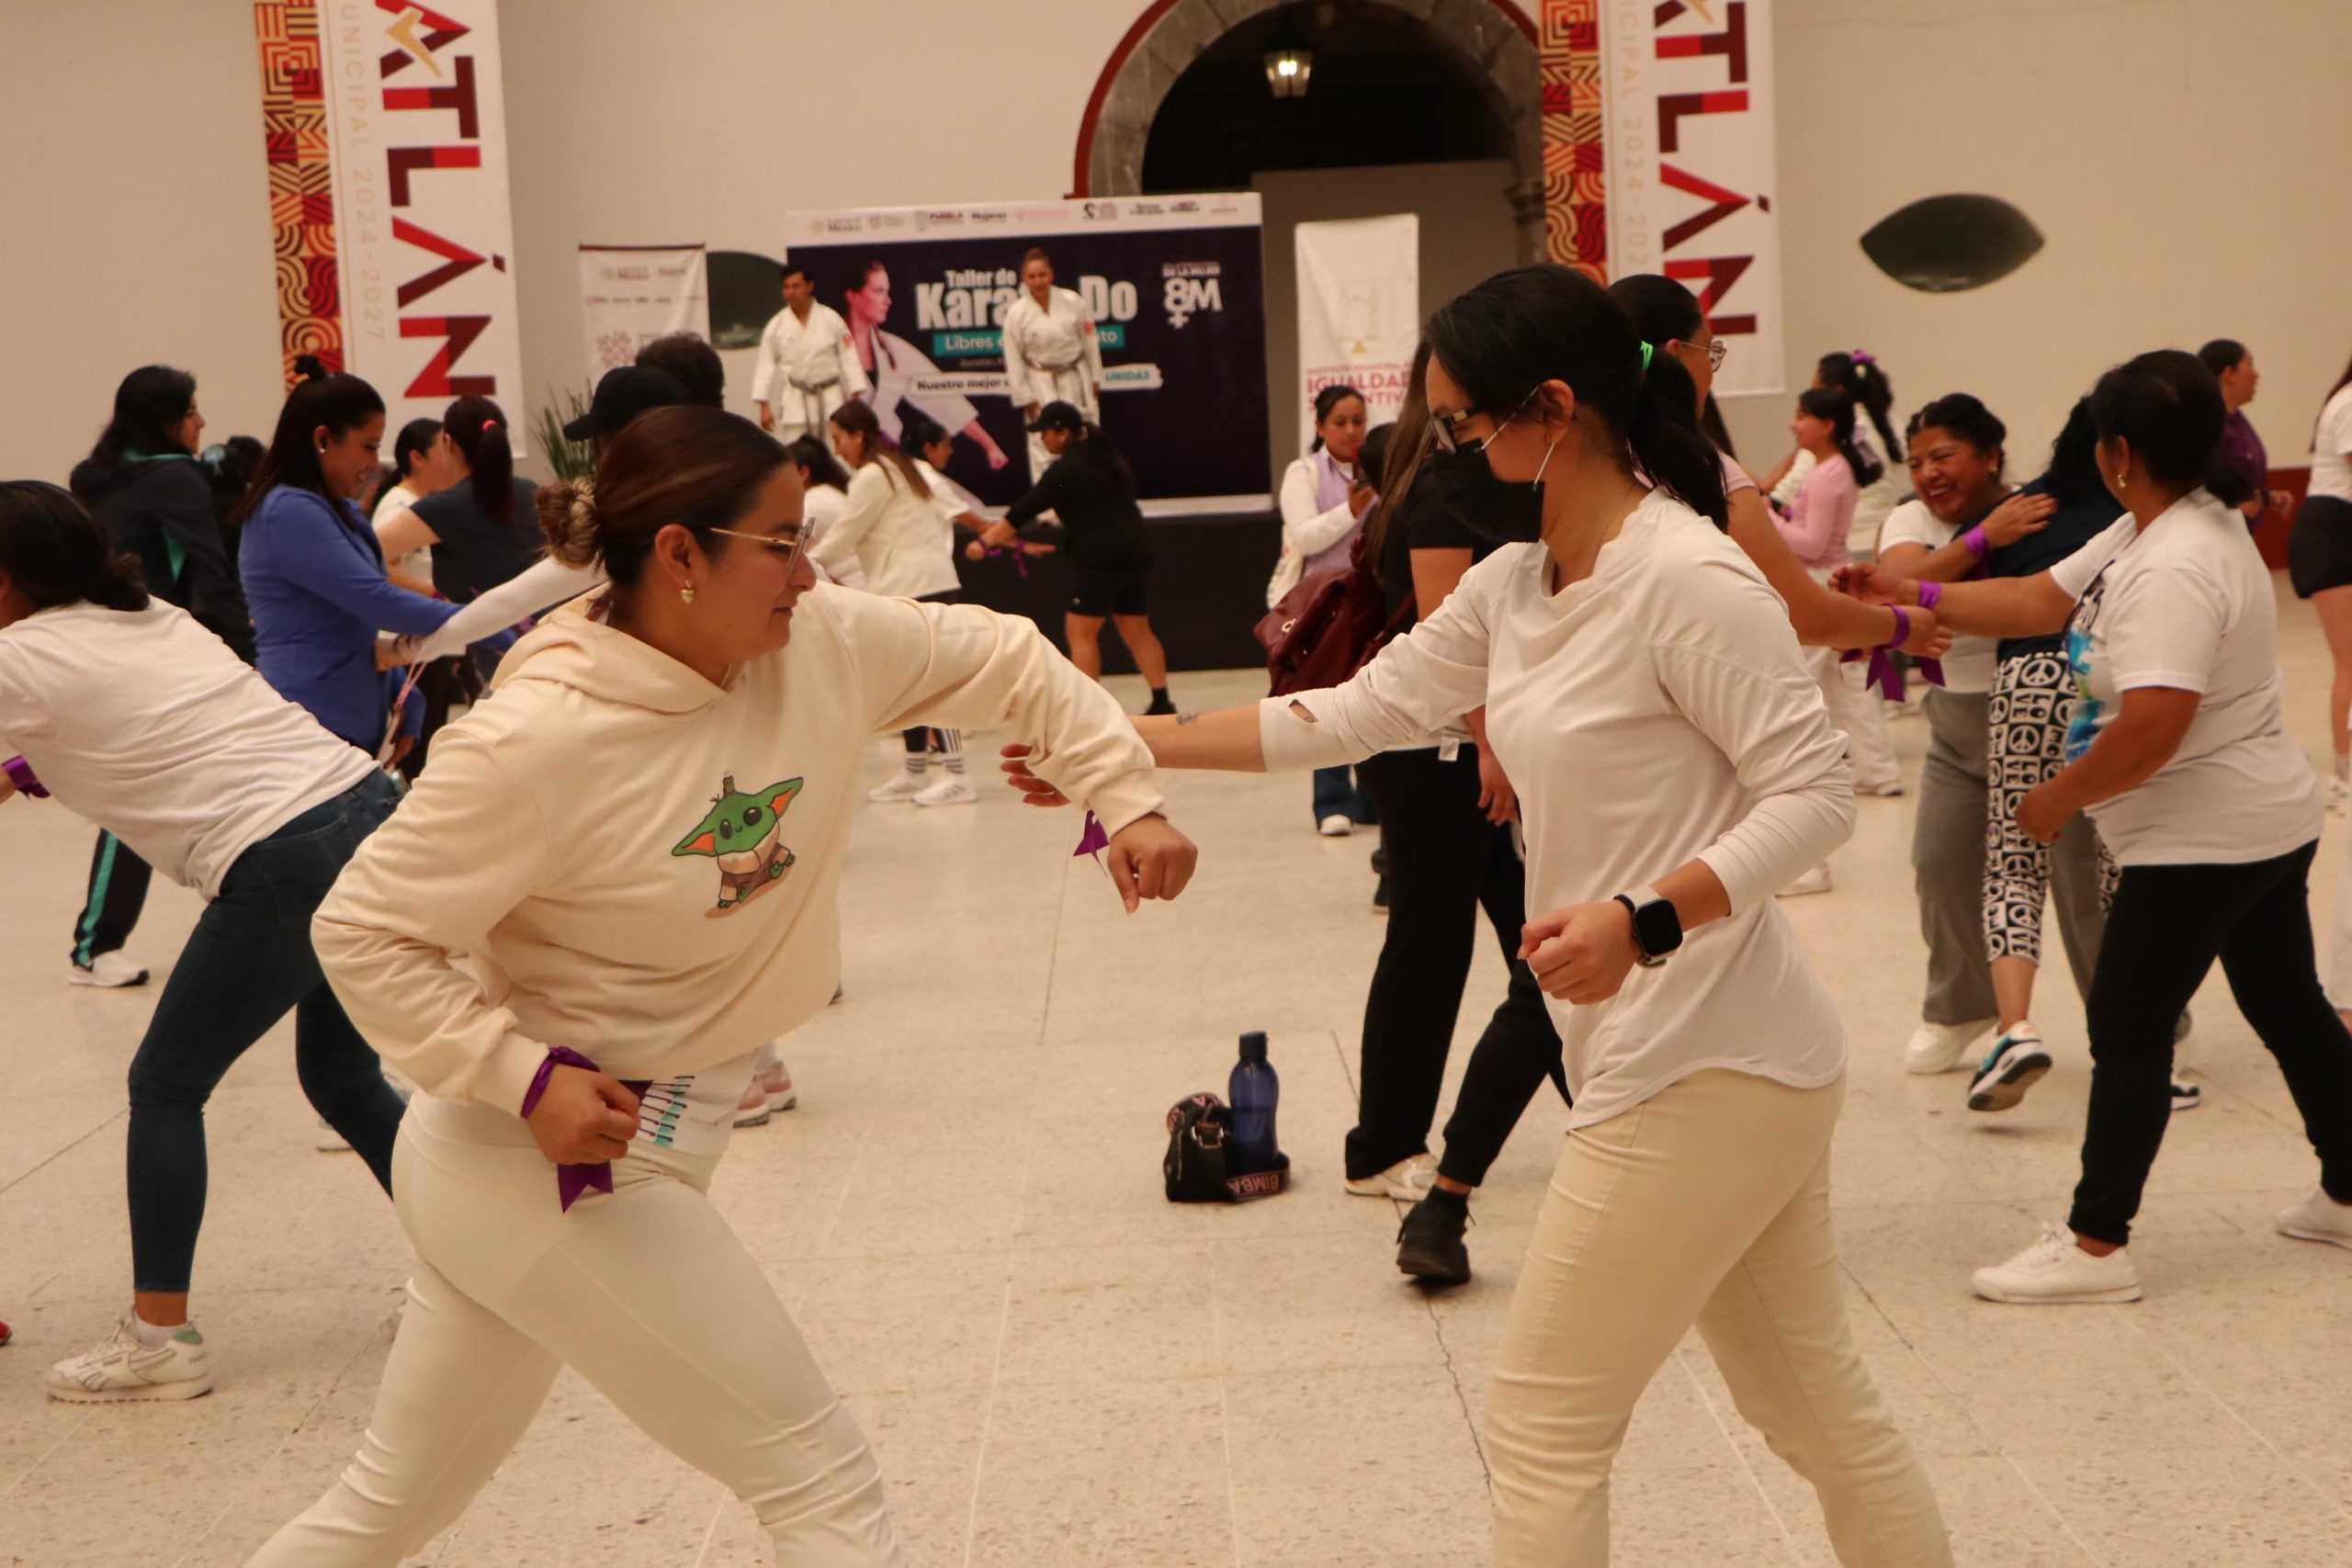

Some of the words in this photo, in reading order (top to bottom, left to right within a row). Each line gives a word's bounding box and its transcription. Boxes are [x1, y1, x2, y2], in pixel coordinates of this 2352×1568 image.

[1623, 117, 1649, 266] 2024-202
[354, 169, 386, 340] 2024-2027
[944, 269, 993, 288] Taller
[994, 267, 1017, 286] de
[945, 333, 994, 352] Libres
[917, 379, 965, 390] Nuestro
[967, 377, 1001, 390] mejor
